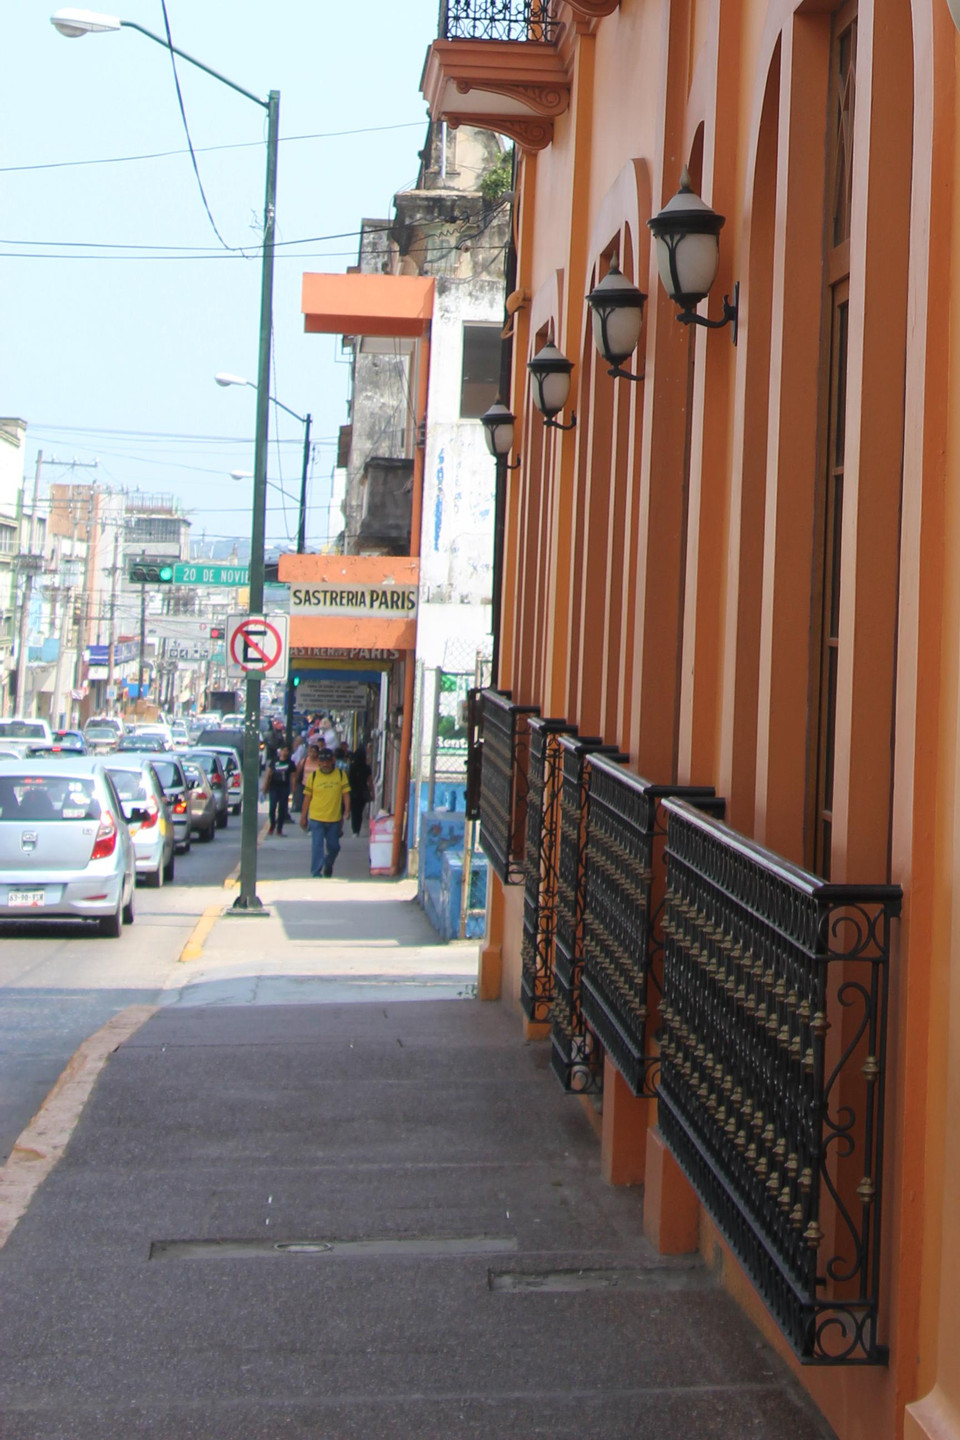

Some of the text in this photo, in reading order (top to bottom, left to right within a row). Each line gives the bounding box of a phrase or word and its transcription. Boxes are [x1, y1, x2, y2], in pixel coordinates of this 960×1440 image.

[183, 568, 196, 581] 20
[203, 568, 215, 582] DE
[293, 589, 416, 610] SASTRERIA PARIS
[243, 629, 267, 663] E
